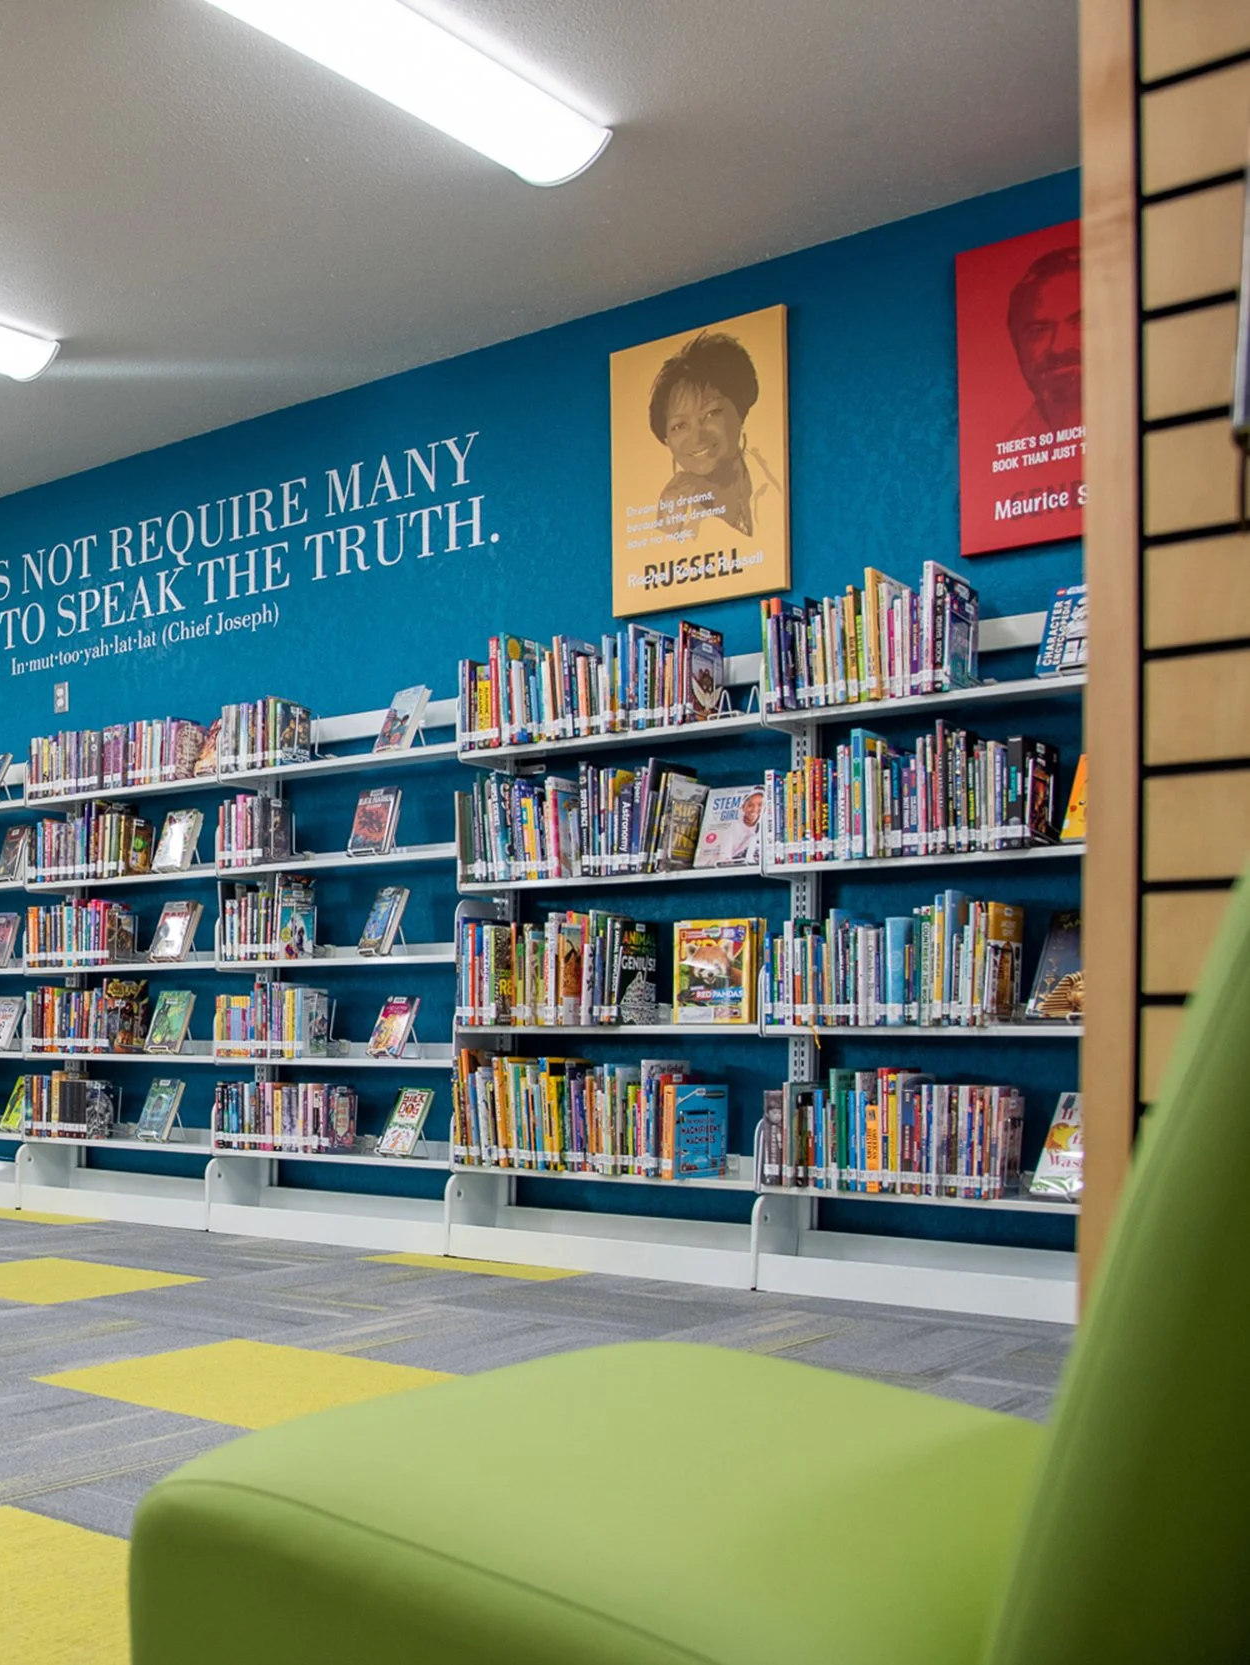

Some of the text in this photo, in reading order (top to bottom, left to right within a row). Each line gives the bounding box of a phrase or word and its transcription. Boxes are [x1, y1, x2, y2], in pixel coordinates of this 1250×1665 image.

[996, 436, 1037, 455] THERE'S
[1039, 432, 1053, 446] SO
[992, 456, 1019, 473] BOOK
[1021, 450, 1049, 467] THAN
[1051, 444, 1077, 460] JUST
[21, 534, 97, 594] NOT
[108, 477, 308, 572] REQUIRE
[324, 431, 480, 518] MANY
[660, 499, 675, 513] big
[689, 504, 727, 520] dreams
[994, 491, 1069, 521] Maurice
[0, 602, 46, 650] TO
[57, 566, 186, 638] SPEAK
[197, 541, 290, 605] THE
[304, 495, 500, 582] TRUTH.
[644, 548, 744, 590] RUSSELL
[162, 614, 213, 649] (Chief
[215, 602, 280, 637] Joseph)
[1042, 600, 1065, 666] CHARACTER
[712, 796, 742, 811] STEM
[720, 810, 740, 821] GIRL
[619, 801, 631, 852] Astronomy
[621, 955, 657, 972] GENIUS!
[696, 989, 743, 999] RED PANDAS
